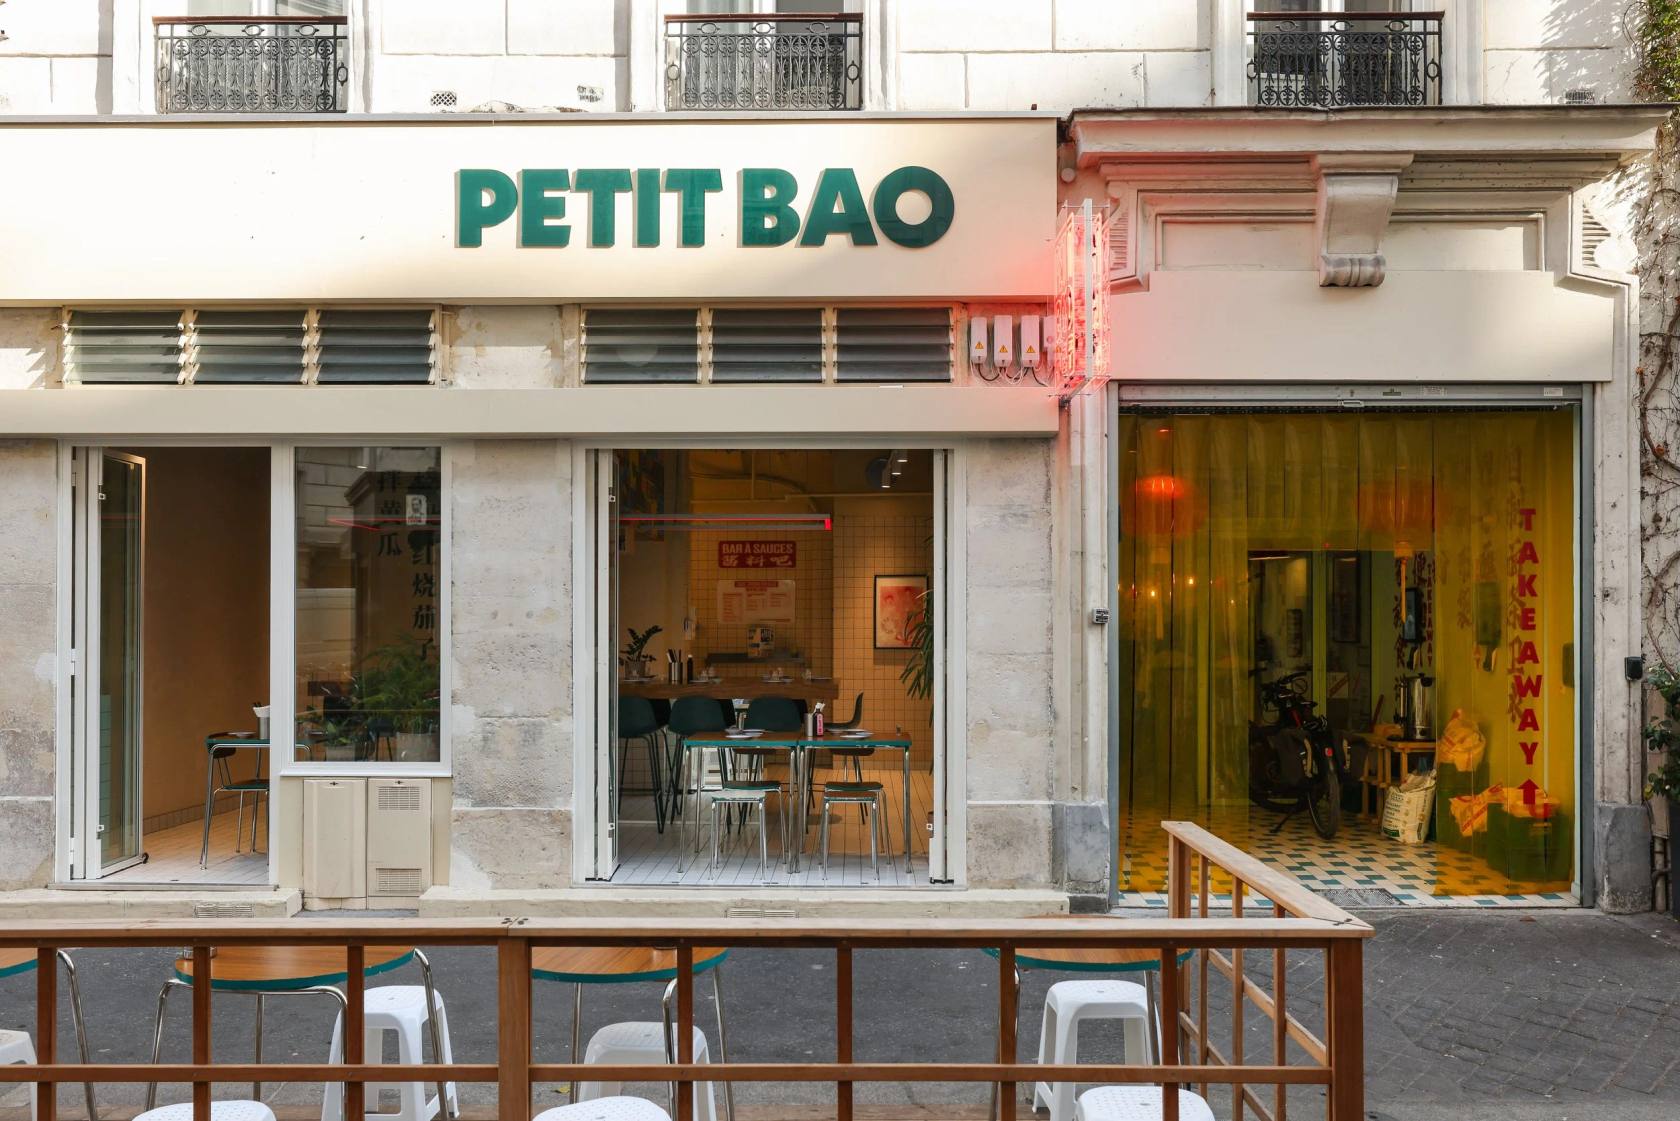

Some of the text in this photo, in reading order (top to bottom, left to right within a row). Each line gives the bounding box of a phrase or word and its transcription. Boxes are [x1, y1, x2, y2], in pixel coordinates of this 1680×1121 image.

[457, 166, 955, 248] PETIT BAO
[722, 543, 742, 554] BAR
[753, 543, 793, 554] SAUCES
[1513, 508, 1543, 765] TAKEAWAY
